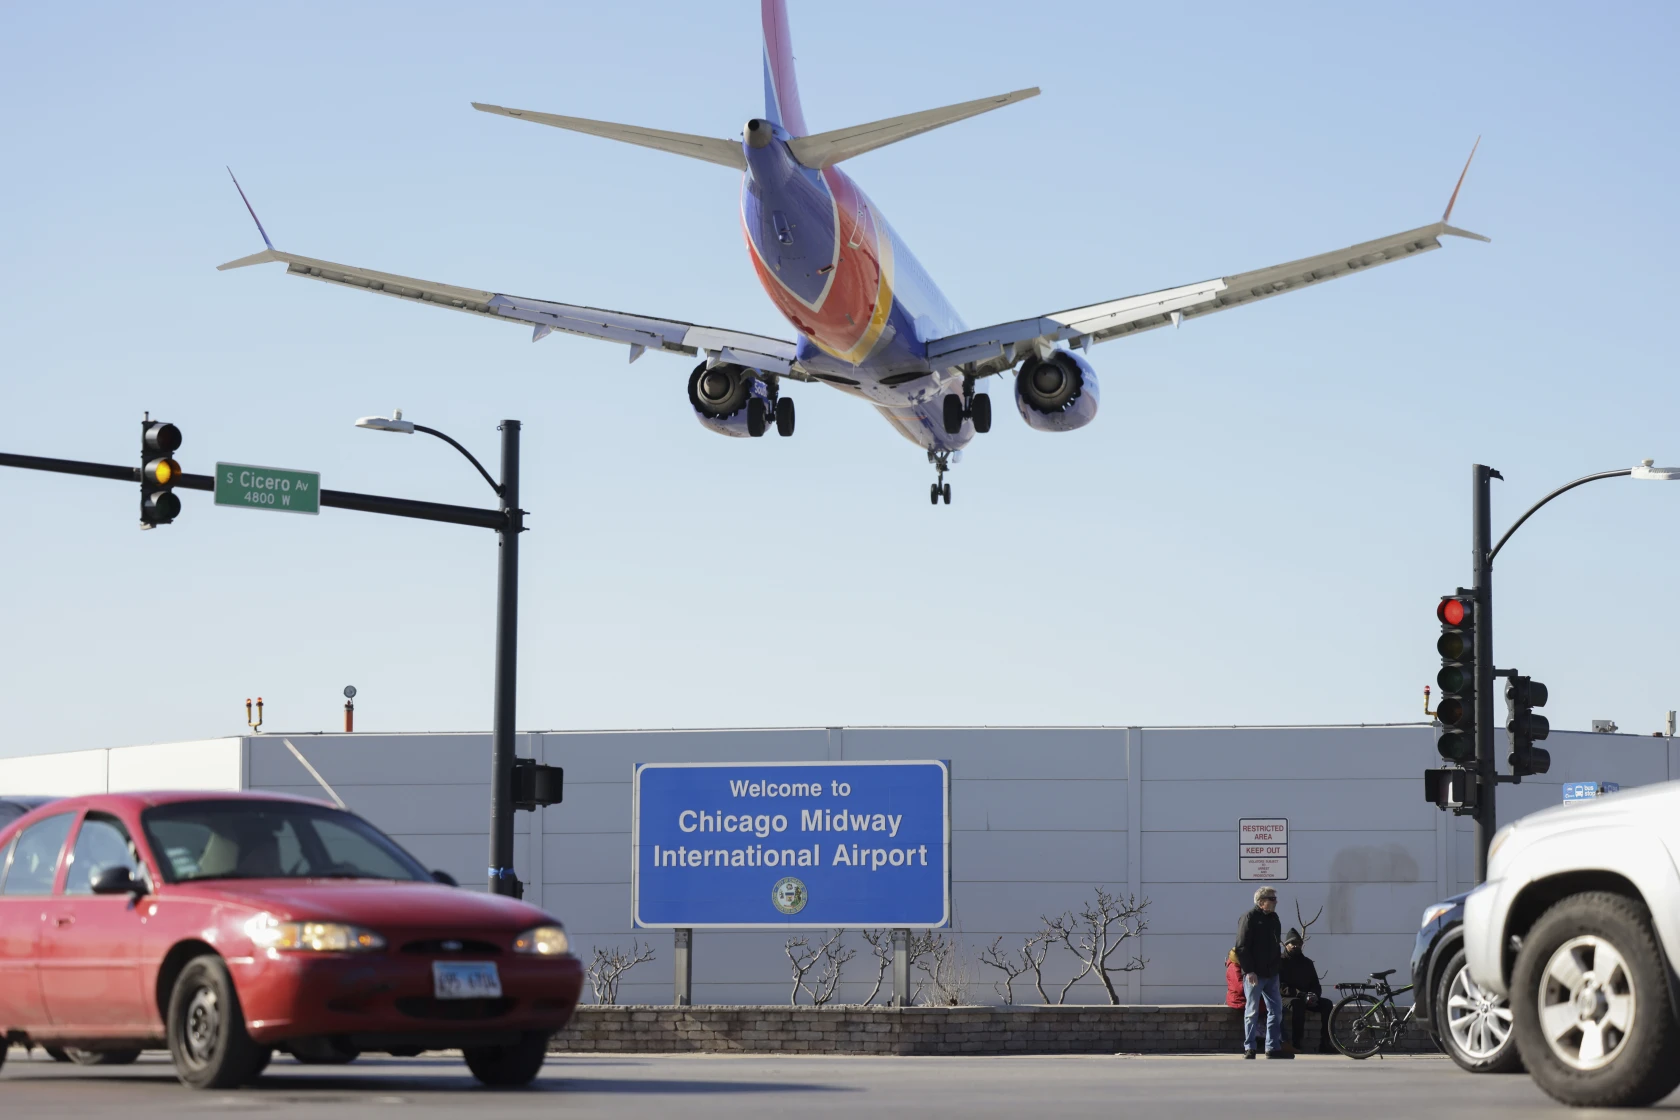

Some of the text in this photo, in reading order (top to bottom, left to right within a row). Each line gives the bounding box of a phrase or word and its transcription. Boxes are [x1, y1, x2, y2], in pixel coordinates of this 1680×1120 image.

[226, 471, 308, 491] S Cicero Av
[244, 492, 290, 506] 4800 W
[730, 780, 852, 798] Welcome to
[678, 809, 902, 838] Chicago Midway
[654, 844, 928, 871] International Airport
